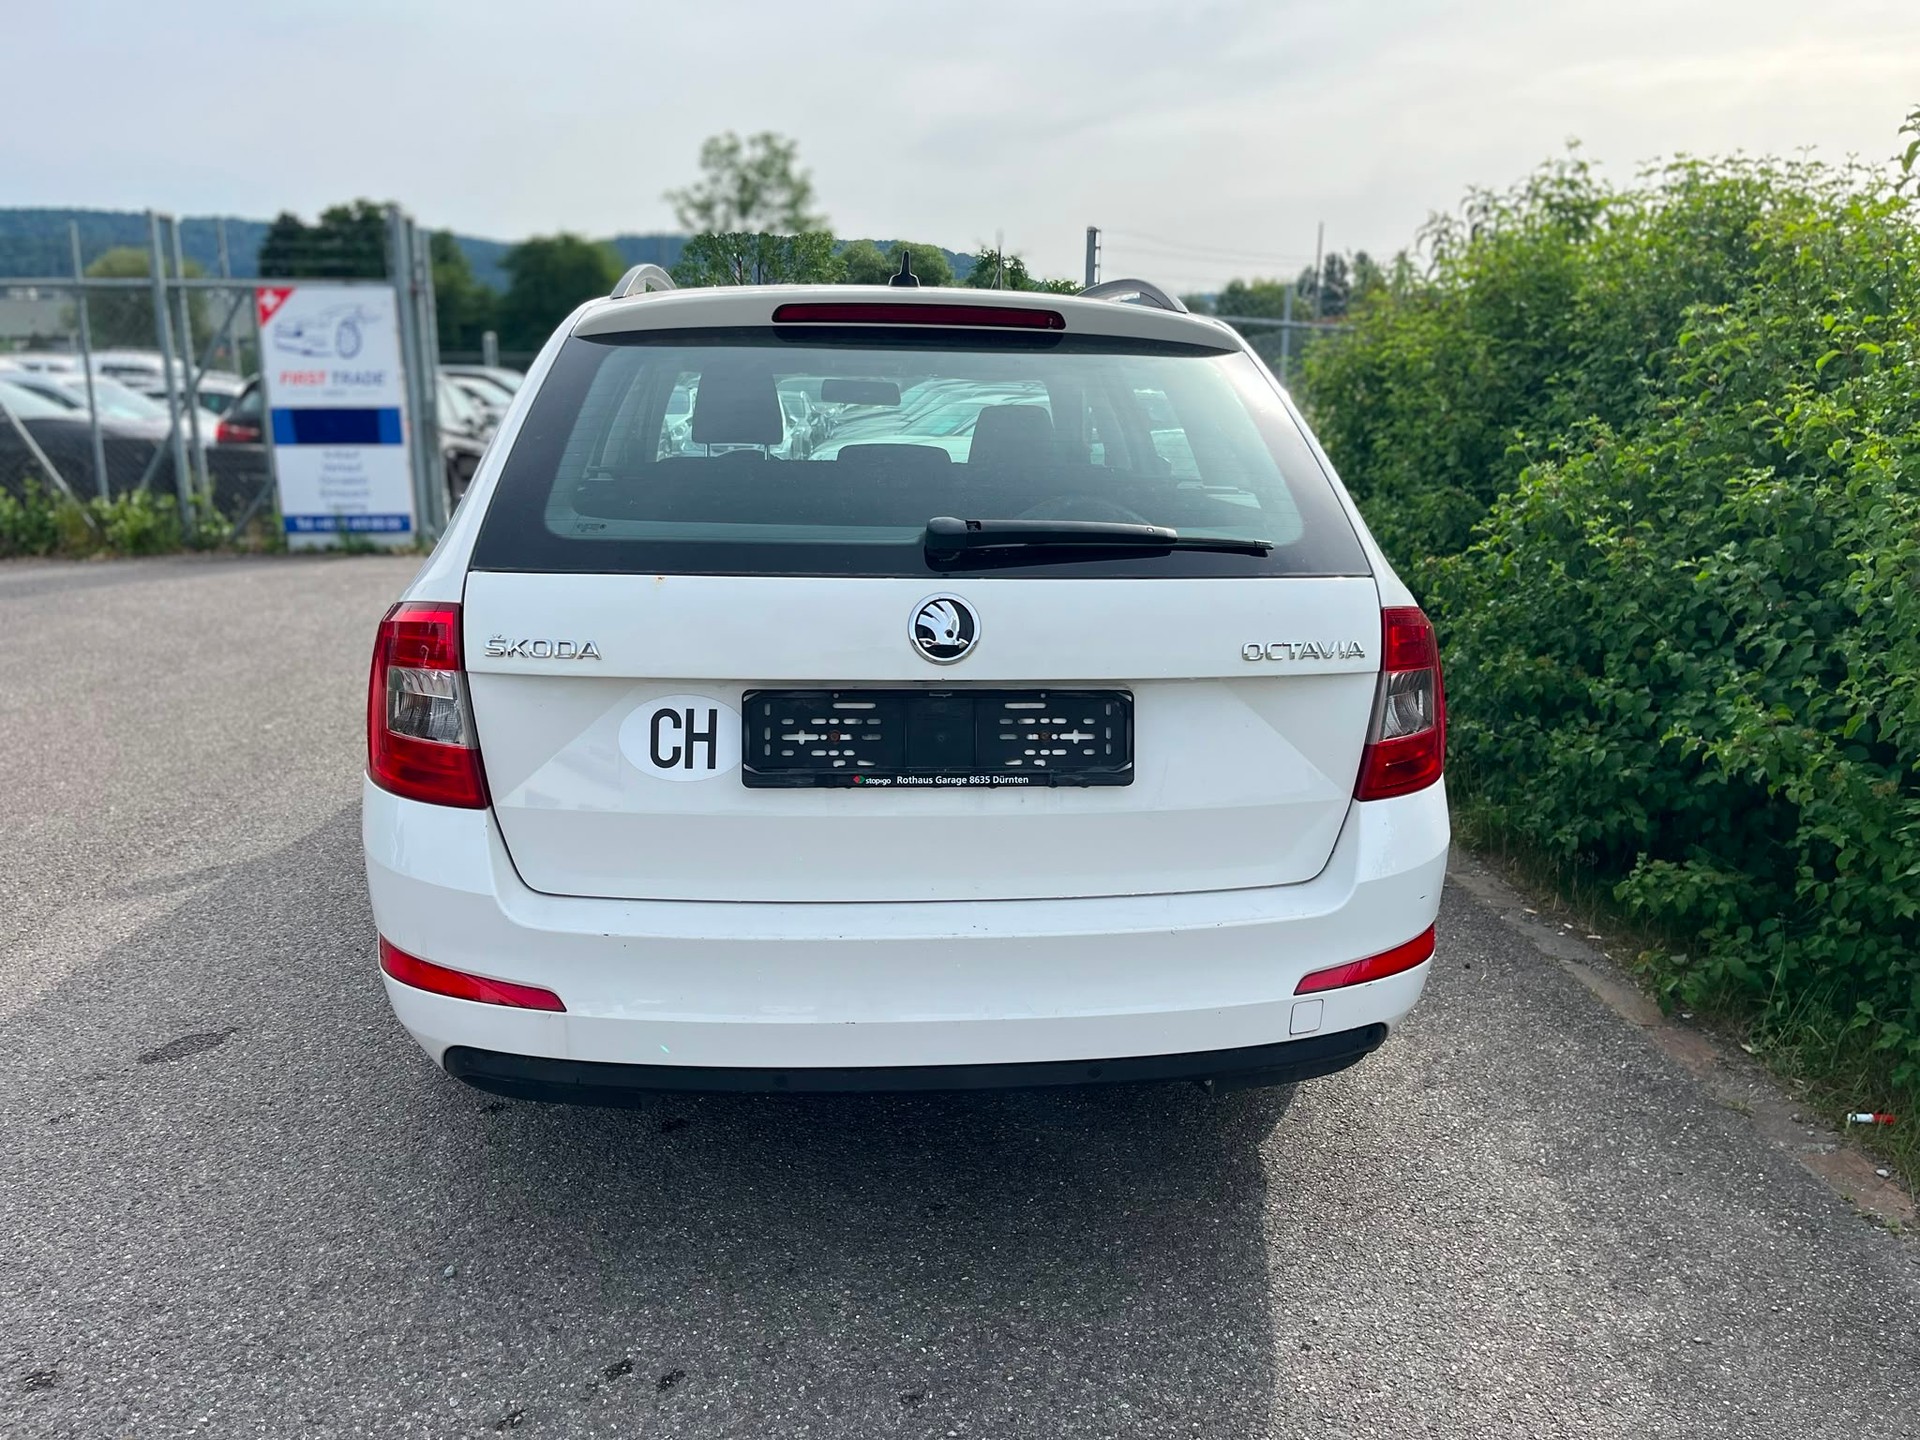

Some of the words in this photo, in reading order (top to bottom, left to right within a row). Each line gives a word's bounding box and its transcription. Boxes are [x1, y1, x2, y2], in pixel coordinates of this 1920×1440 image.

[279, 370, 326, 385] FIRST
[331, 370, 386, 386] TRADE
[484, 634, 602, 660] ŠKODA
[1241, 640, 1366, 662] OCTAVIA
[650, 708, 717, 769] CH
[896, 775, 933, 785] Rothaus
[935, 775, 967, 787] Garage
[969, 775, 990, 784] 8635
[992, 774, 1029, 784] Dürnten
